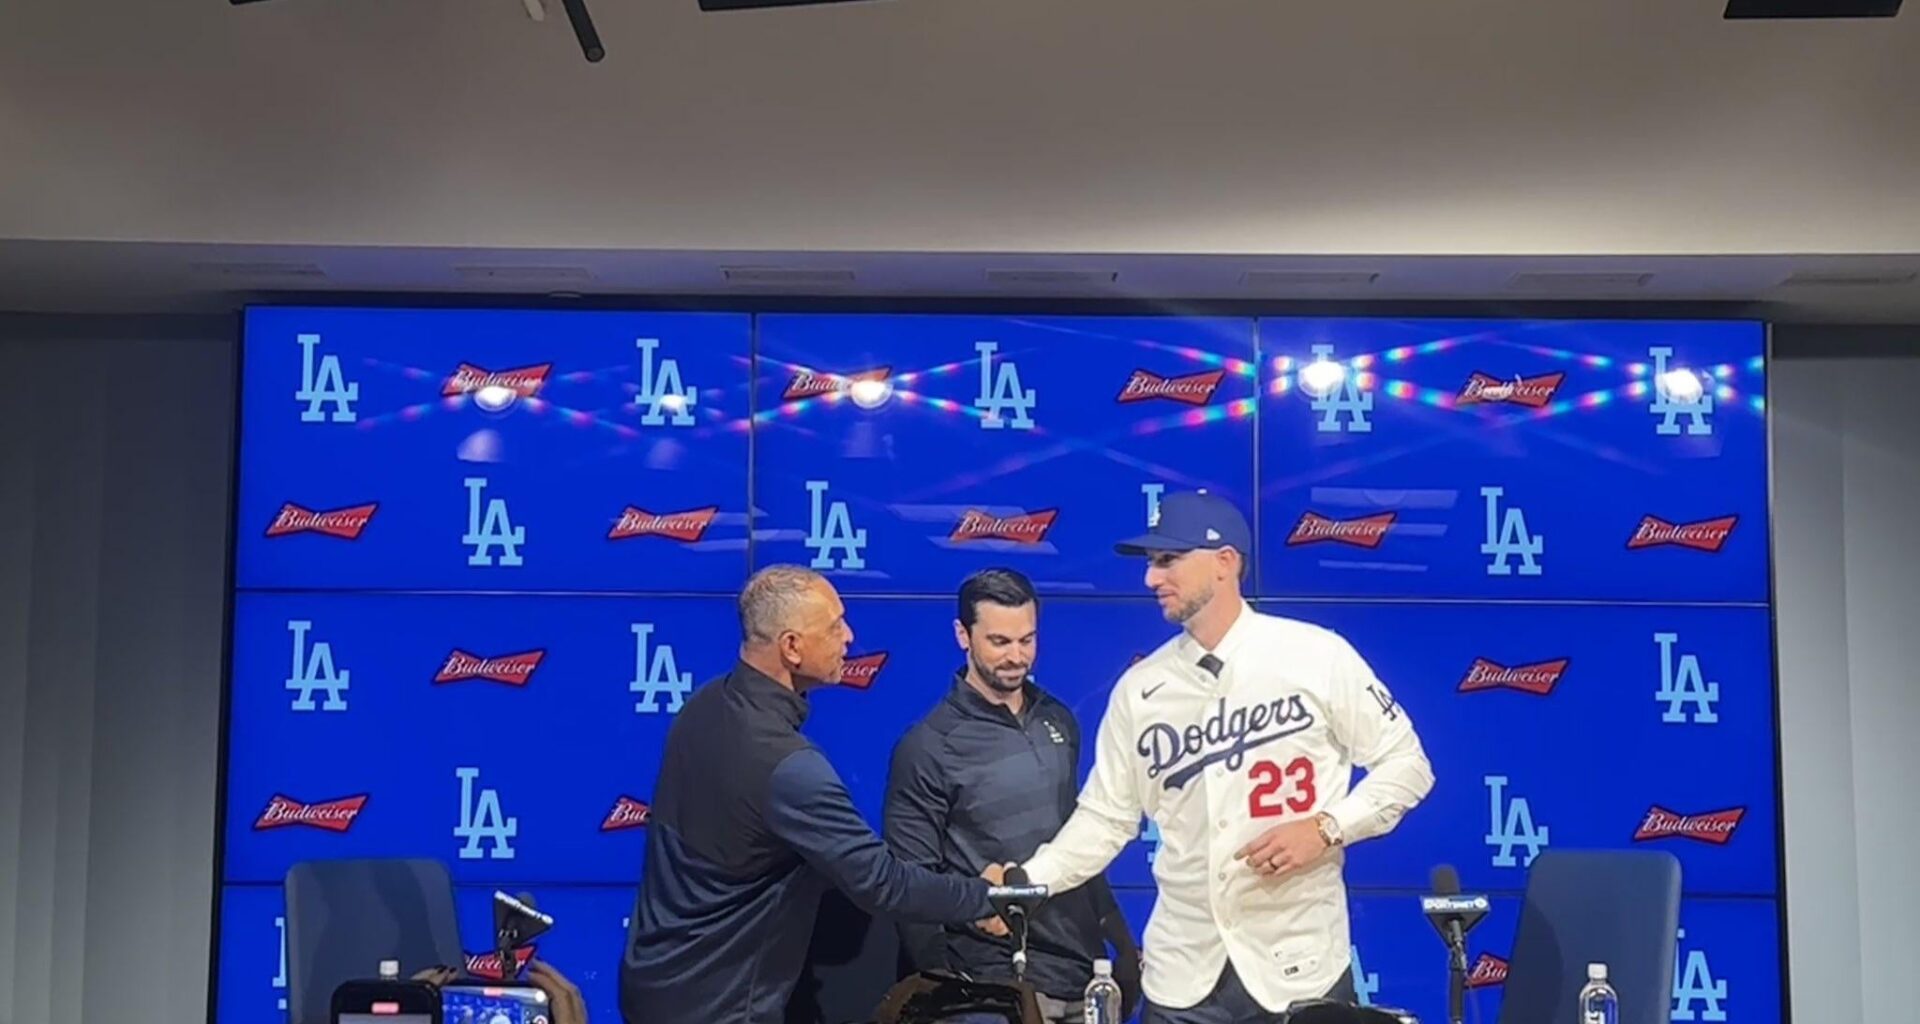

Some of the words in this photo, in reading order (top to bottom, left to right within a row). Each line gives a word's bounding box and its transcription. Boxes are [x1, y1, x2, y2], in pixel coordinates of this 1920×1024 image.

[296, 334, 359, 422] LA
[635, 338, 697, 426] LA
[974, 341, 1036, 430] LA
[1125, 376, 1216, 394] Budweiser
[1311, 344, 1374, 432] LA
[1462, 379, 1555, 397] Bdweiser
[275, 510, 368, 528] Budweiser
[463, 478, 525, 566] LA
[616, 512, 708, 531] Budweiser
[805, 481, 867, 569] LA
[958, 517, 1049, 533] Budweiser
[1294, 519, 1387, 537] Budweiser
[1480, 486, 1543, 575] LA
[1635, 522, 1729, 540] Budweiser
[285, 620, 350, 711] LA
[442, 656, 537, 675] Budweiser
[629, 623, 692, 713] LA
[1467, 664, 1561, 683] Budweiser
[1654, 632, 1719, 723] LA
[1137, 694, 1315, 790] Dodgers
[262, 802, 359, 821] Budweiser
[453, 767, 517, 859] LA
[1248, 756, 1317, 818] 23
[1484, 776, 1549, 867] LA
[1641, 812, 1737, 832] Budweiser
